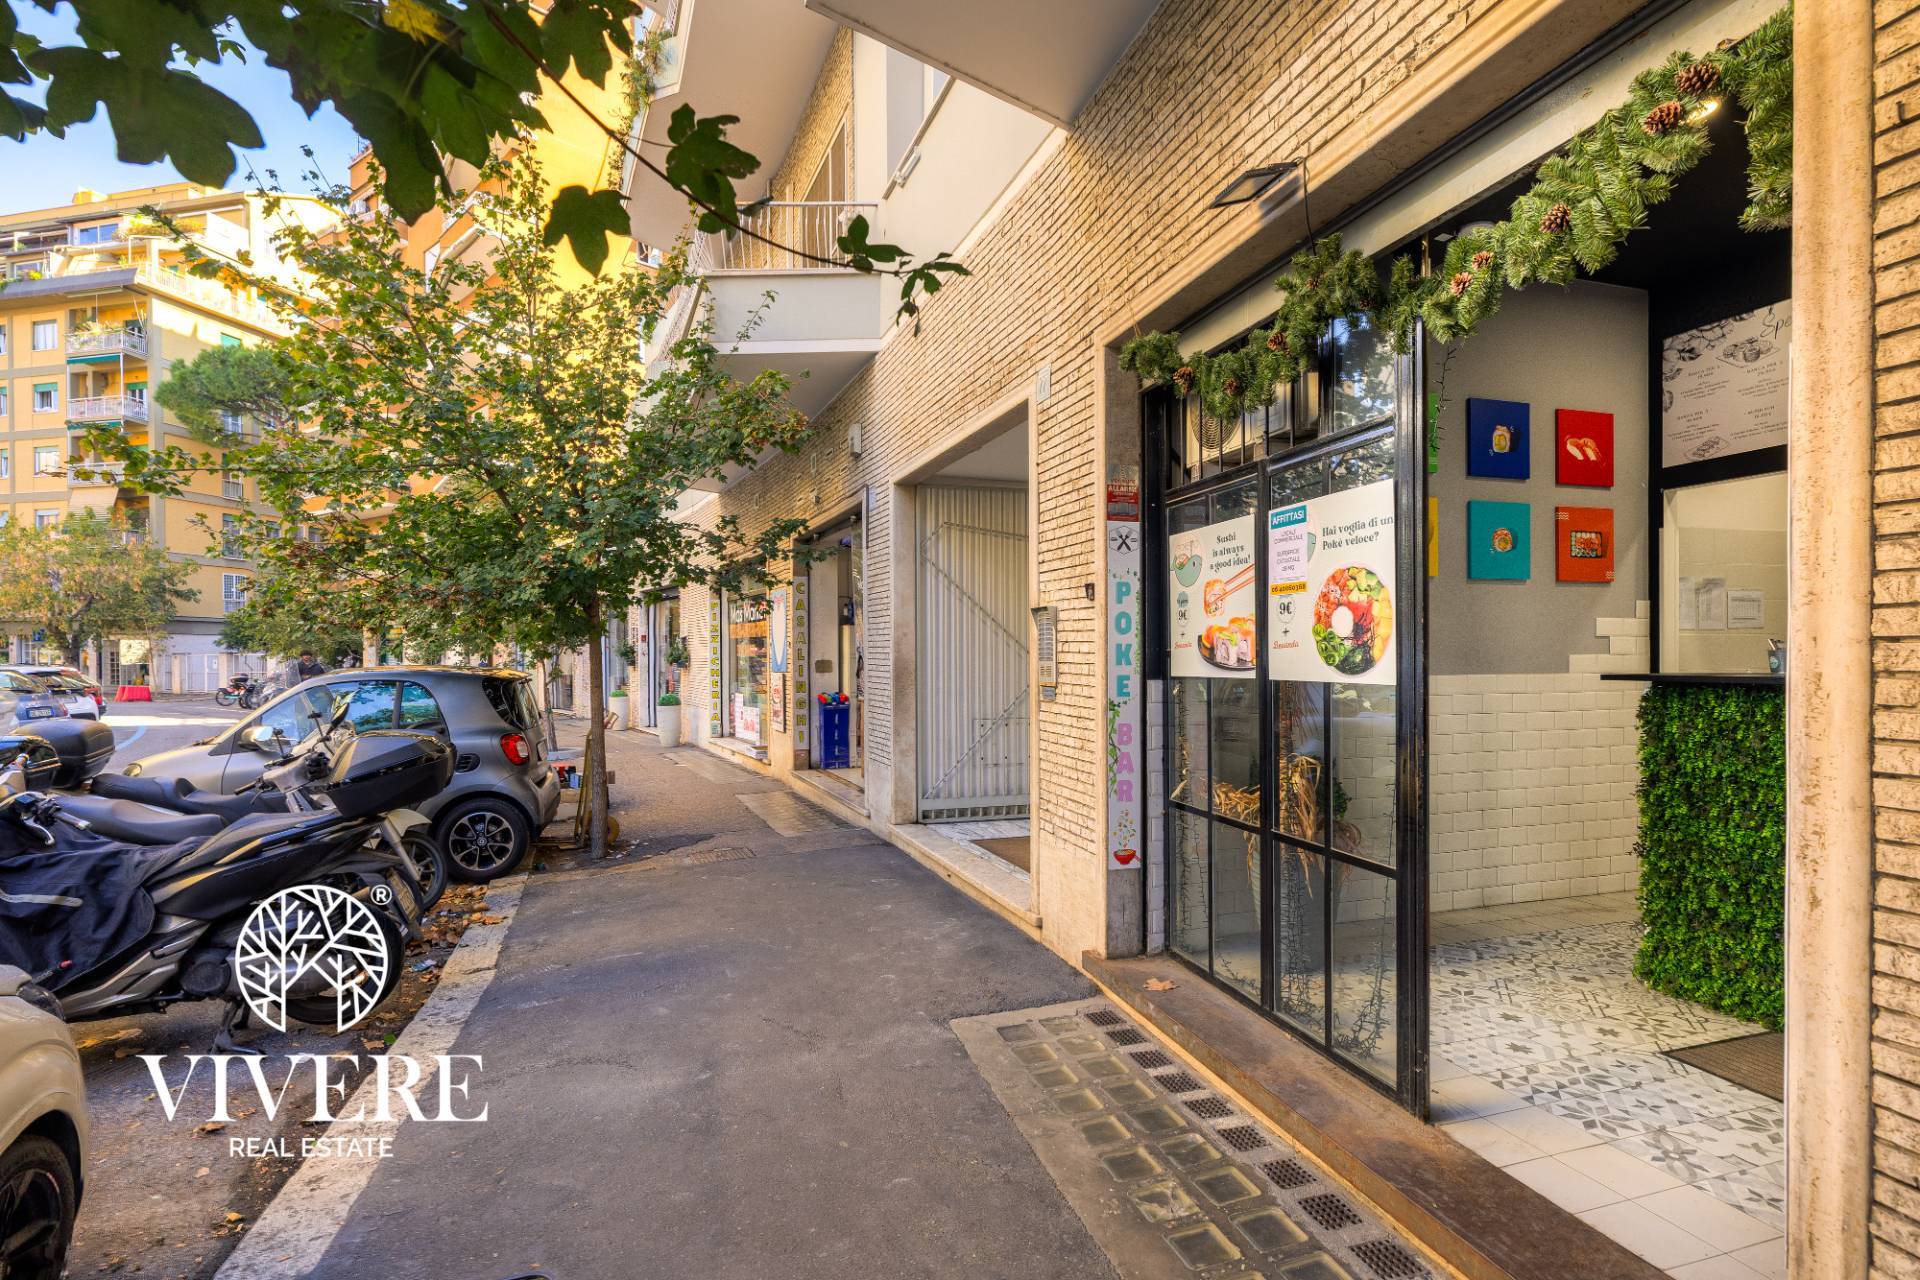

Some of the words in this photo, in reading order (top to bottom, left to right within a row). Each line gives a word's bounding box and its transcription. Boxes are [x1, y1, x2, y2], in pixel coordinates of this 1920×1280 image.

[1271, 509, 1304, 525] AFFITTASI
[1322, 526, 1336, 536] Hai
[1338, 519, 1366, 536] voglia
[1368, 516, 1378, 527] di
[1216, 531, 1236, 543] Sushi
[1345, 531, 1379, 546] veloce?
[1215, 559, 1231, 573] good
[1278, 601, 1292, 614] 9€
[1115, 581, 1133, 698] POKE
[795, 582, 807, 744] CASALINGHI
[1115, 723, 1135, 802] BAR
